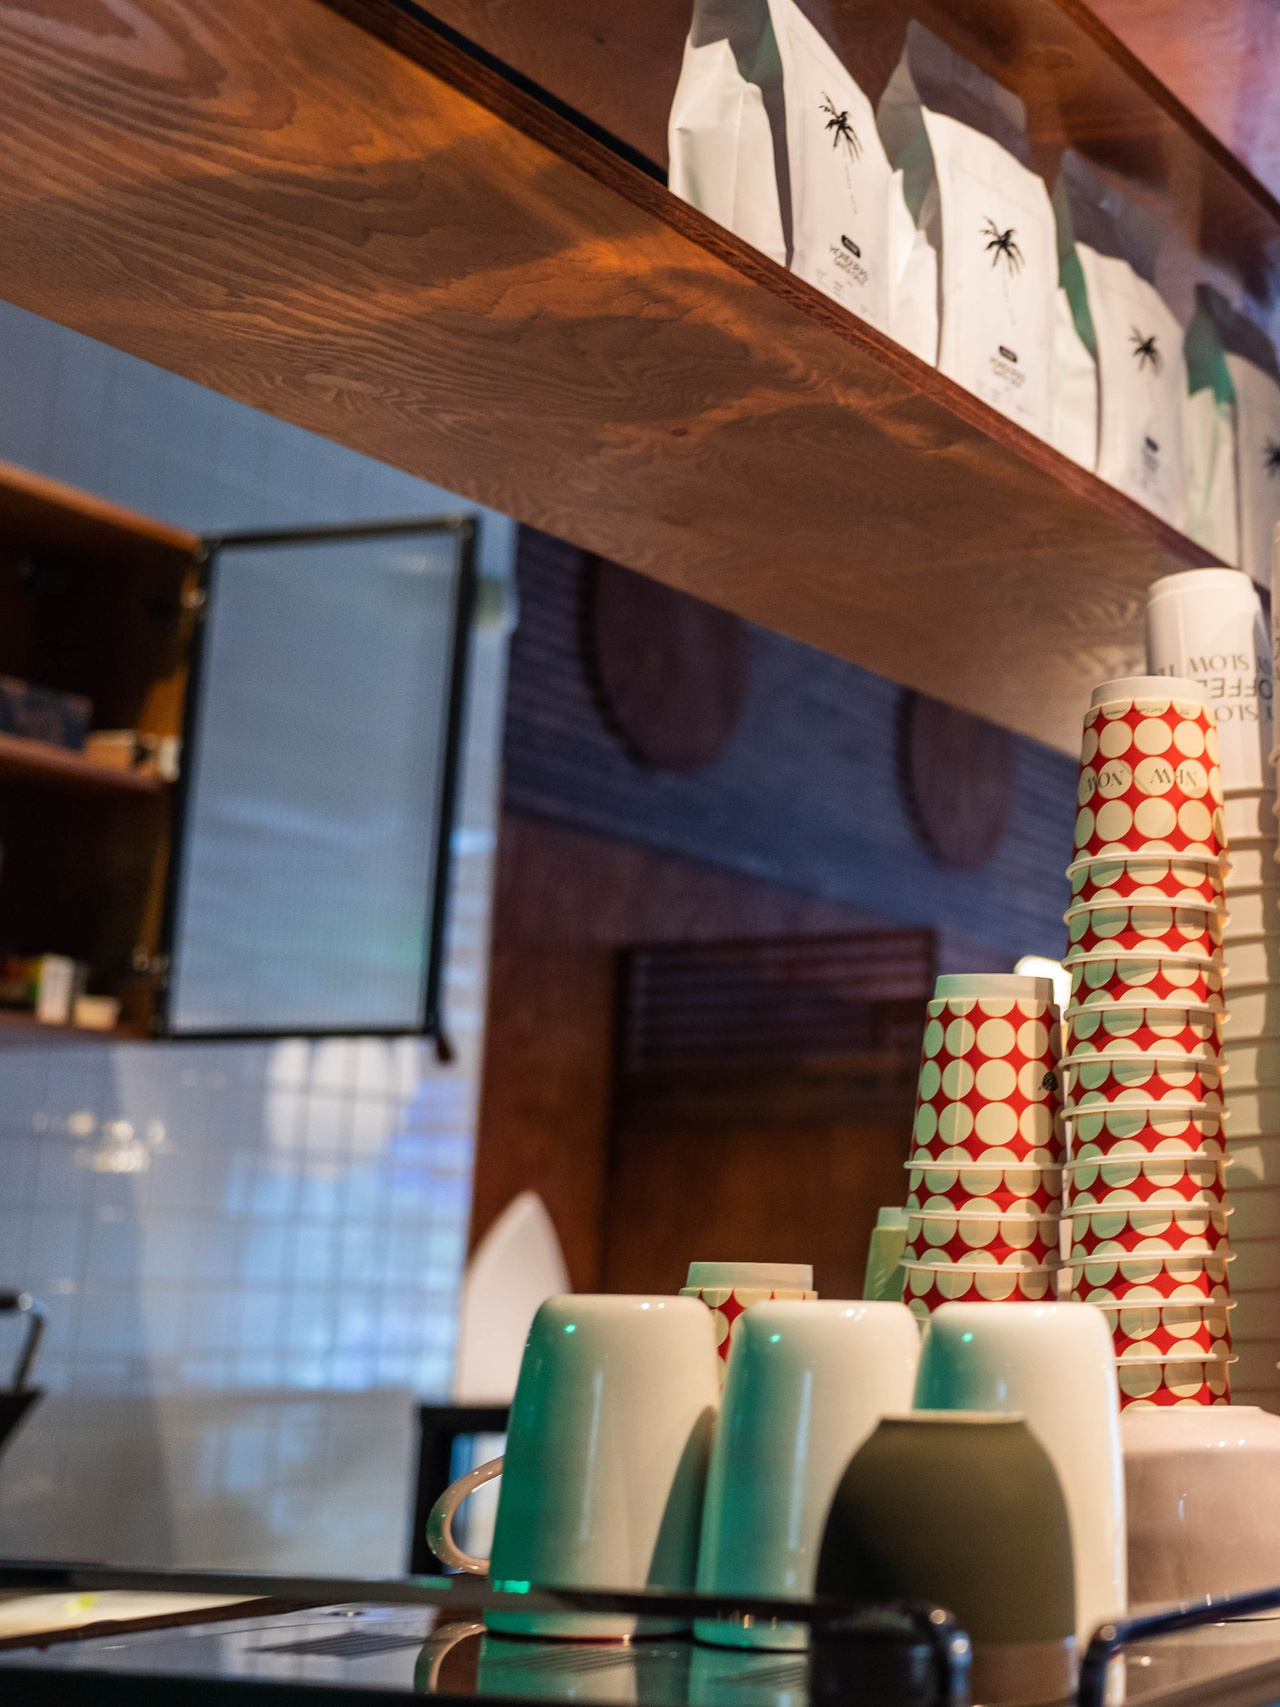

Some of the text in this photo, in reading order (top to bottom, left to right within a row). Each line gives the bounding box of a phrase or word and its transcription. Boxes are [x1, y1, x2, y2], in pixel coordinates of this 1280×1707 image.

[1188, 655, 1250, 674] SLOW
[1196, 677, 1274, 700] OFFE
[1213, 704, 1259, 723] SLO
[1080, 769, 1125, 795] NOW
